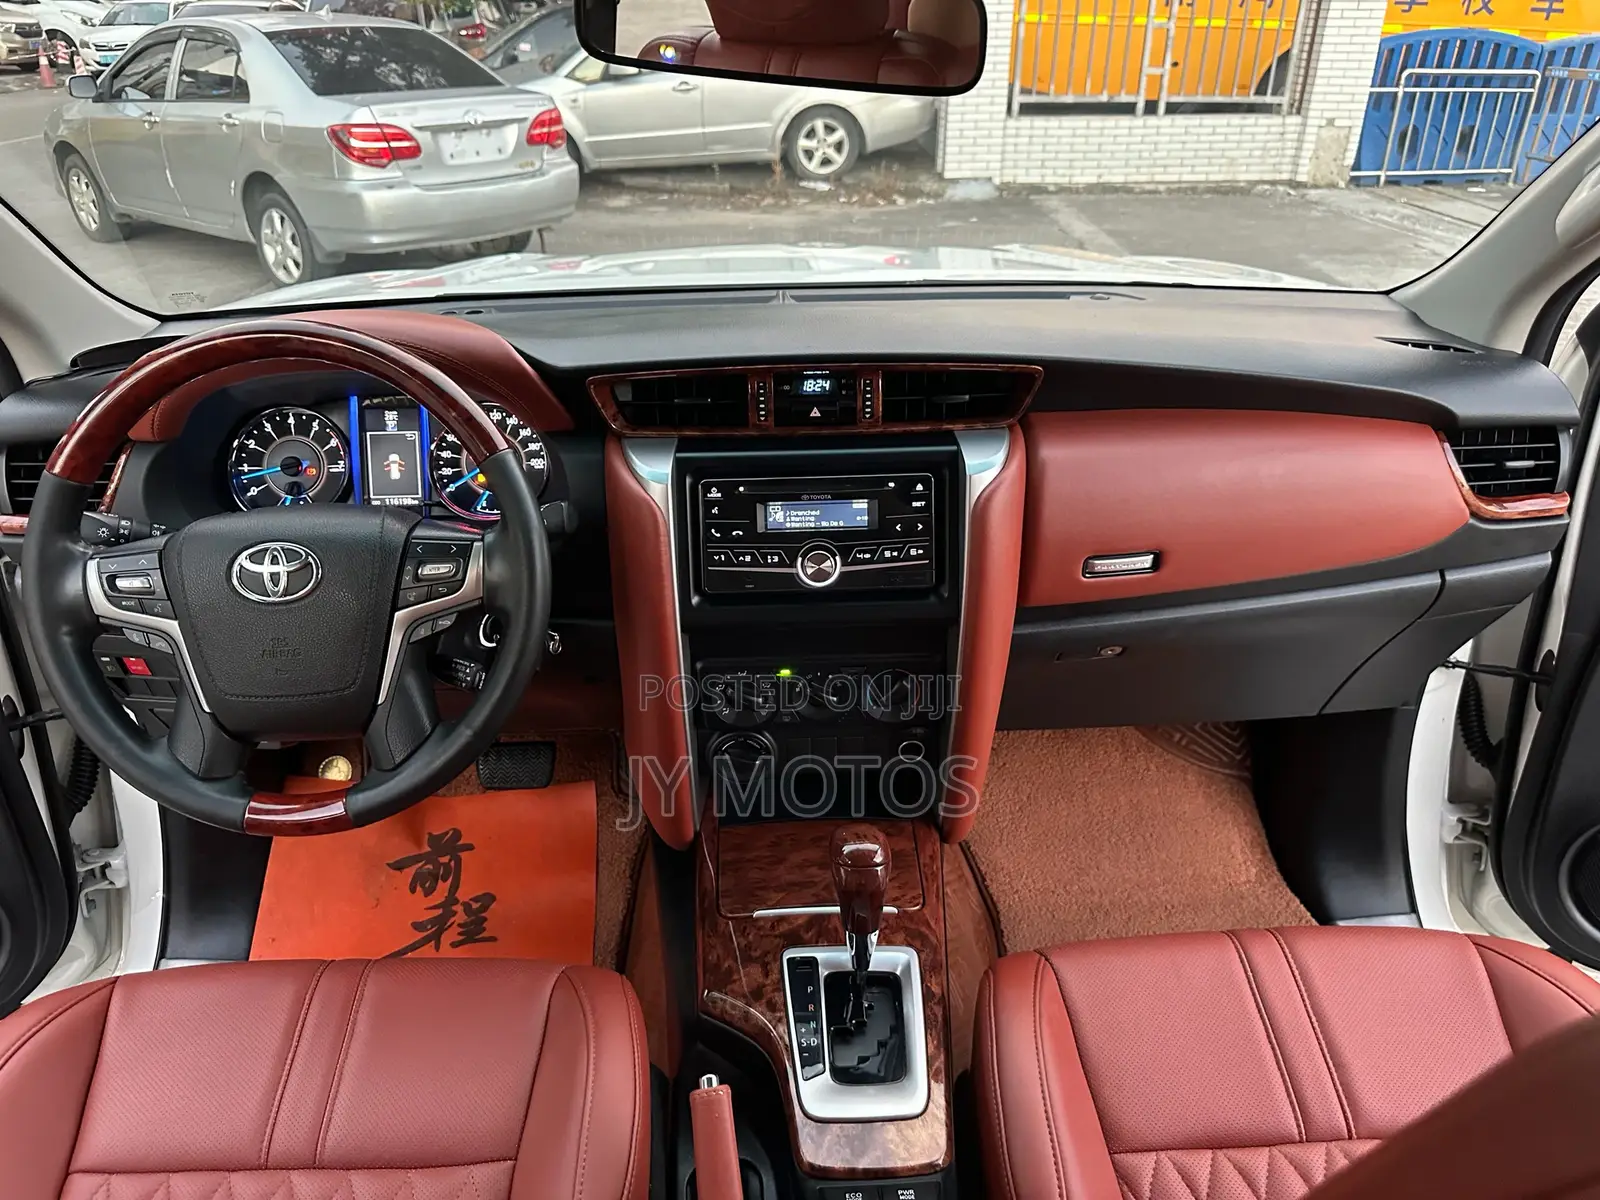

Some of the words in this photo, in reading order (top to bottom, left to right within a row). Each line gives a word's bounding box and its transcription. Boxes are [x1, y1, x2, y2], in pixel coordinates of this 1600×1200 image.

[803, 379, 830, 391] 18:24
[264, 422, 272, 432] 3
[312, 421, 319, 431] 5
[248, 439, 256, 449] 2
[329, 438, 338, 447] 6
[441, 450, 452, 458] 40
[441, 468, 453, 476] 20
[250, 486, 258, 496] 0
[380, 828, 498, 960] 前程
[807, 985, 814, 994] P
[808, 1003, 815, 1012] R
[810, 1020, 817, 1029] N
